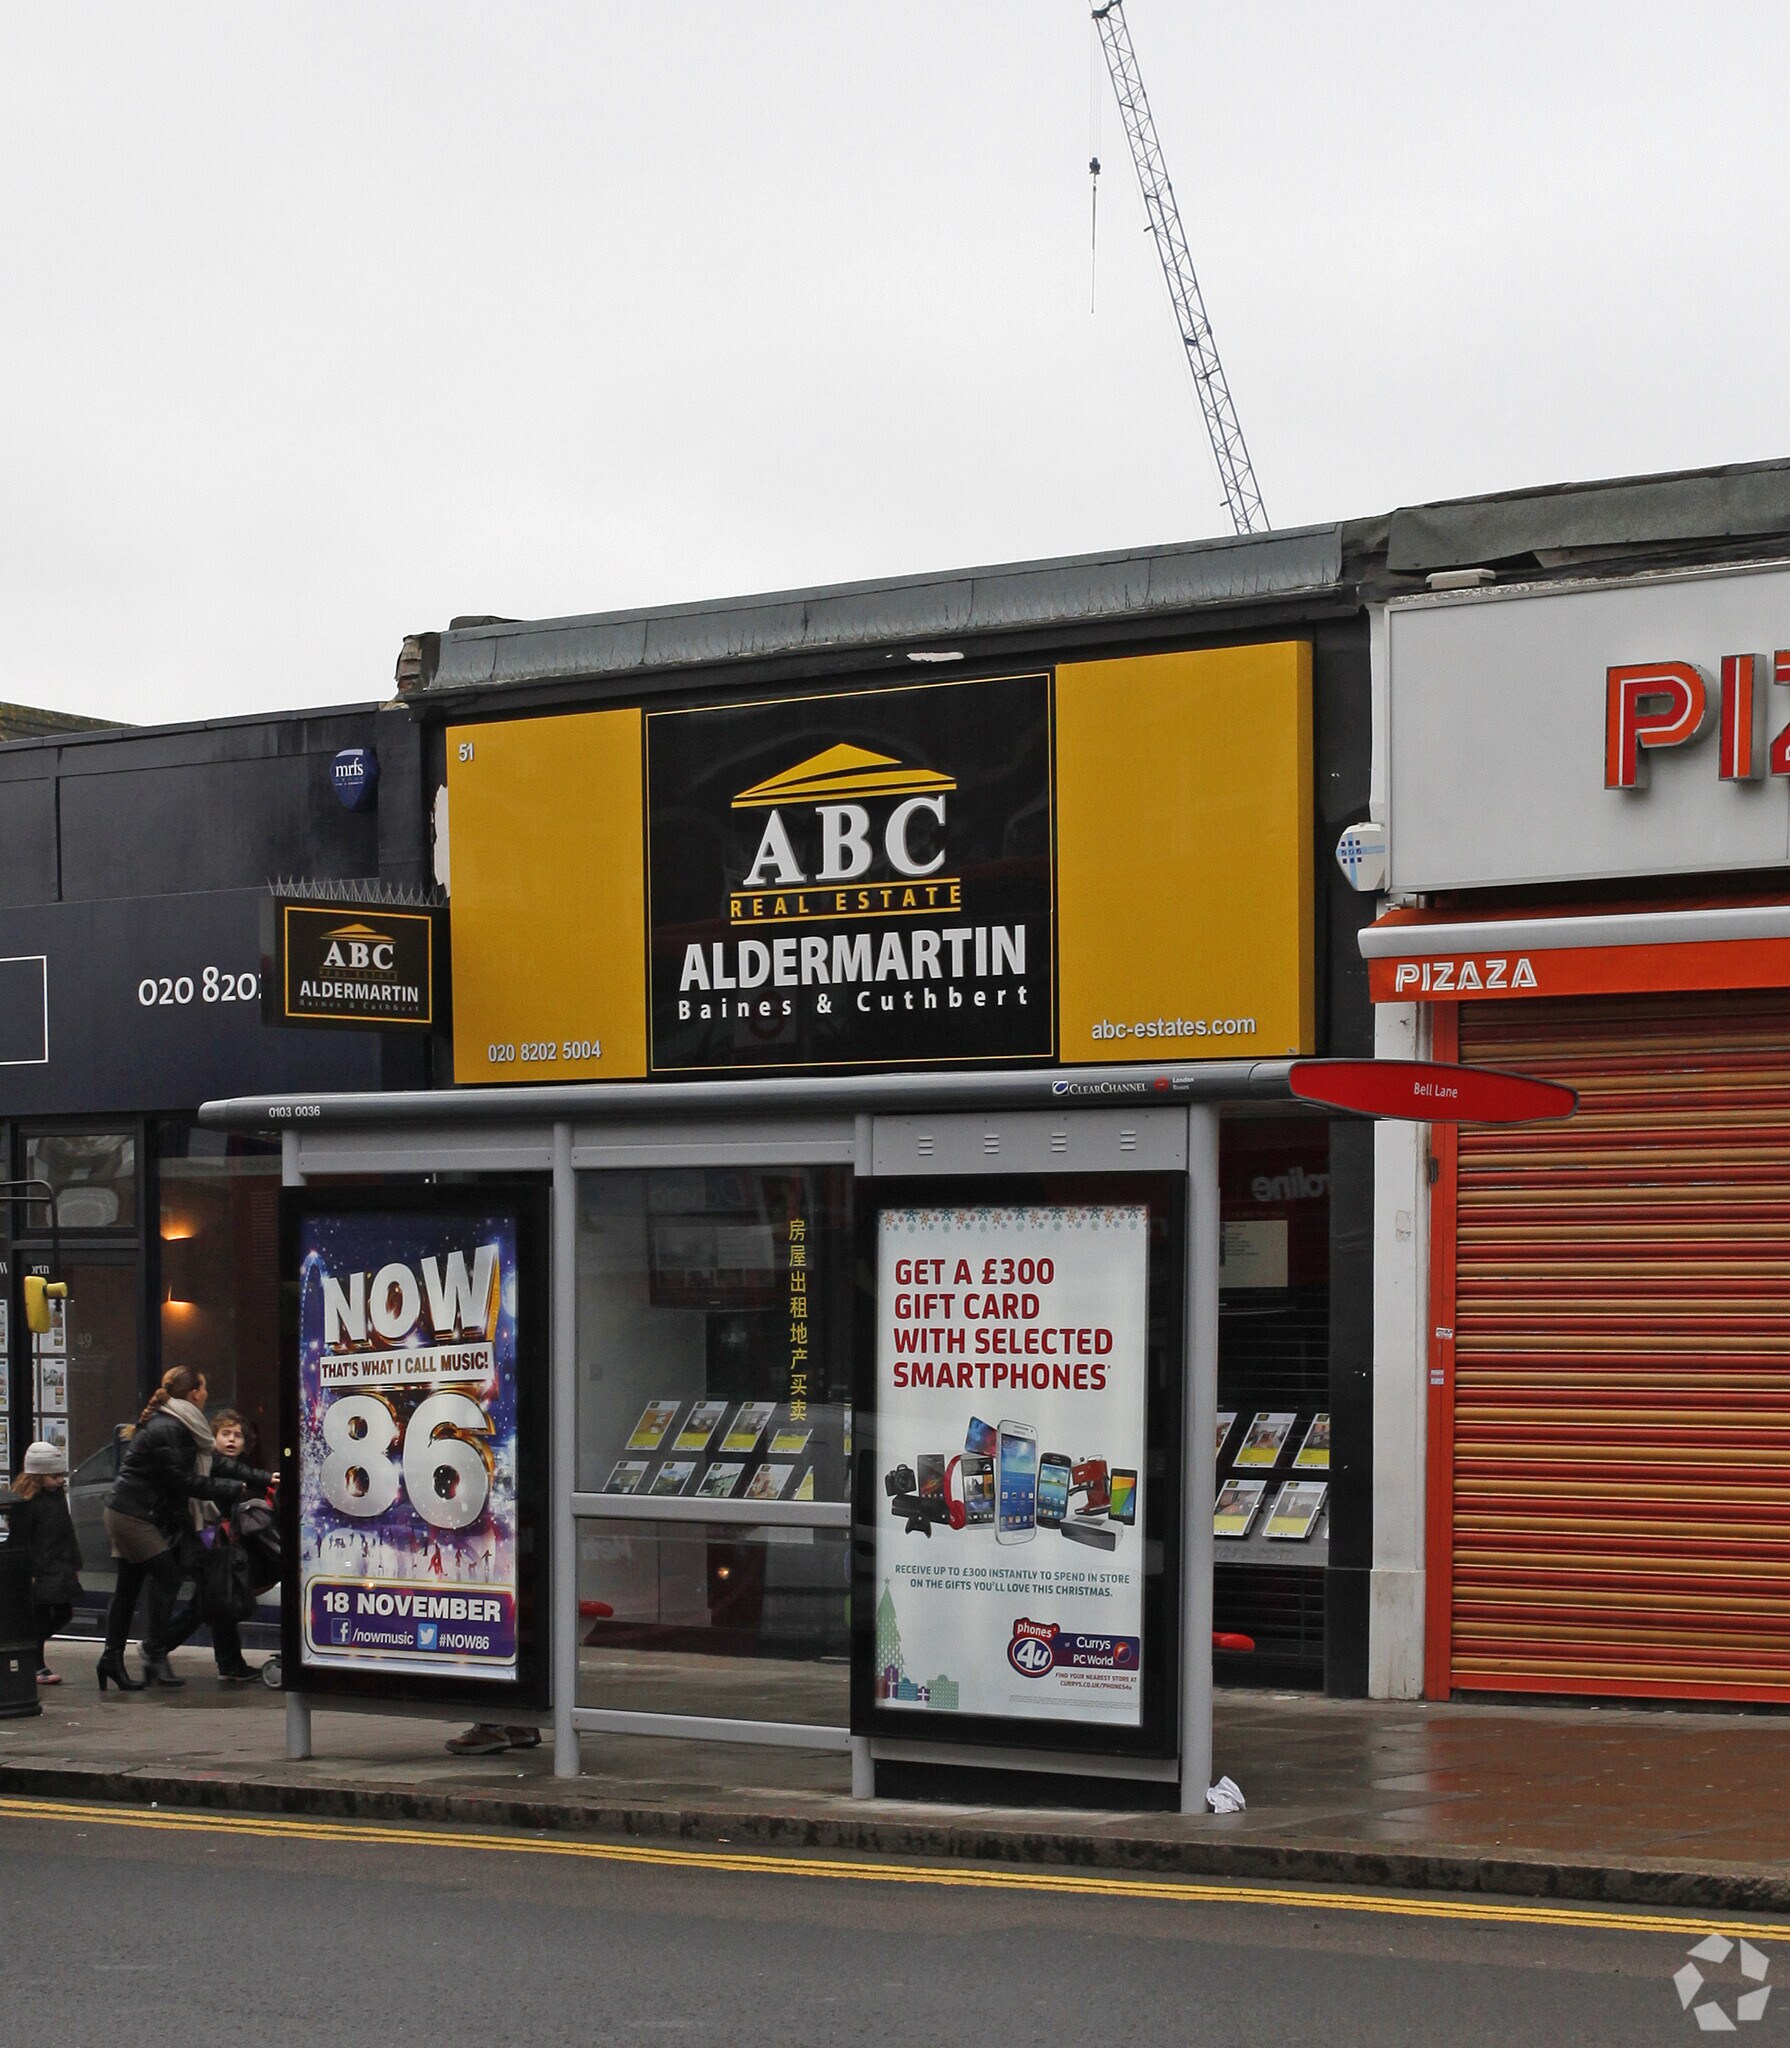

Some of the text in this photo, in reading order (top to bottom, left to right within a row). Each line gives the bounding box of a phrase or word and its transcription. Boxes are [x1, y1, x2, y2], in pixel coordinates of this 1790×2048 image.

[1604, 649, 1790, 790] PI
[459, 743, 474, 762] 51
[335, 757, 364, 777] mrfs
[743, 794, 946, 887] ABC
[730, 885, 961, 918] REAL ESTATE
[323, 941, 394, 970] ABC
[679, 924, 1027, 992] ALDERMARTIN
[138, 966, 262, 1006] 020 820
[1395, 957, 1538, 993] PIZAZA
[300, 980, 419, 1003] ALDERMARTIN
[678, 985, 1028, 1020] Baines & Cuthbert
[1091, 1017, 1257, 1040] abc-estates.com
[487, 1040, 602, 1062] 020 8202 5004
[1413, 1082, 1459, 1099] Bell Lane
[268, 1105, 321, 1118] 0103 0036
[895, 1257, 1055, 1286] GET A £300
[323, 1243, 500, 1345] NOW
[894, 1293, 1040, 1320] GIFT CARD
[789, 1219, 808, 1421] 房屋出租地产买卖
[893, 1327, 1114, 1355] WITH SELECTED
[322, 1351, 489, 1379] THAT'S WHAT I CALL MUSIC!
[320, 1393, 494, 1529] 86
[895, 1564, 1130, 1584] RECEIVE UP TO £300 INSTANTLY TO SPEND IN STORE
[910, 1578, 1113, 1597] ON THE GIFTS YOU'LL LOVE THIS CHRISTMAS.
[323, 1591, 502, 1623] 18 NOVEMBER
[352, 1628, 414, 1646] /nowmusic
[439, 1633, 490, 1650] #NOW86
[1017, 1622, 1052, 1639] phones
[1076, 1636, 1112, 1651] Currys
[1017, 1640, 1049, 1669] 4u
[1073, 1654, 1114, 1666] PC World
